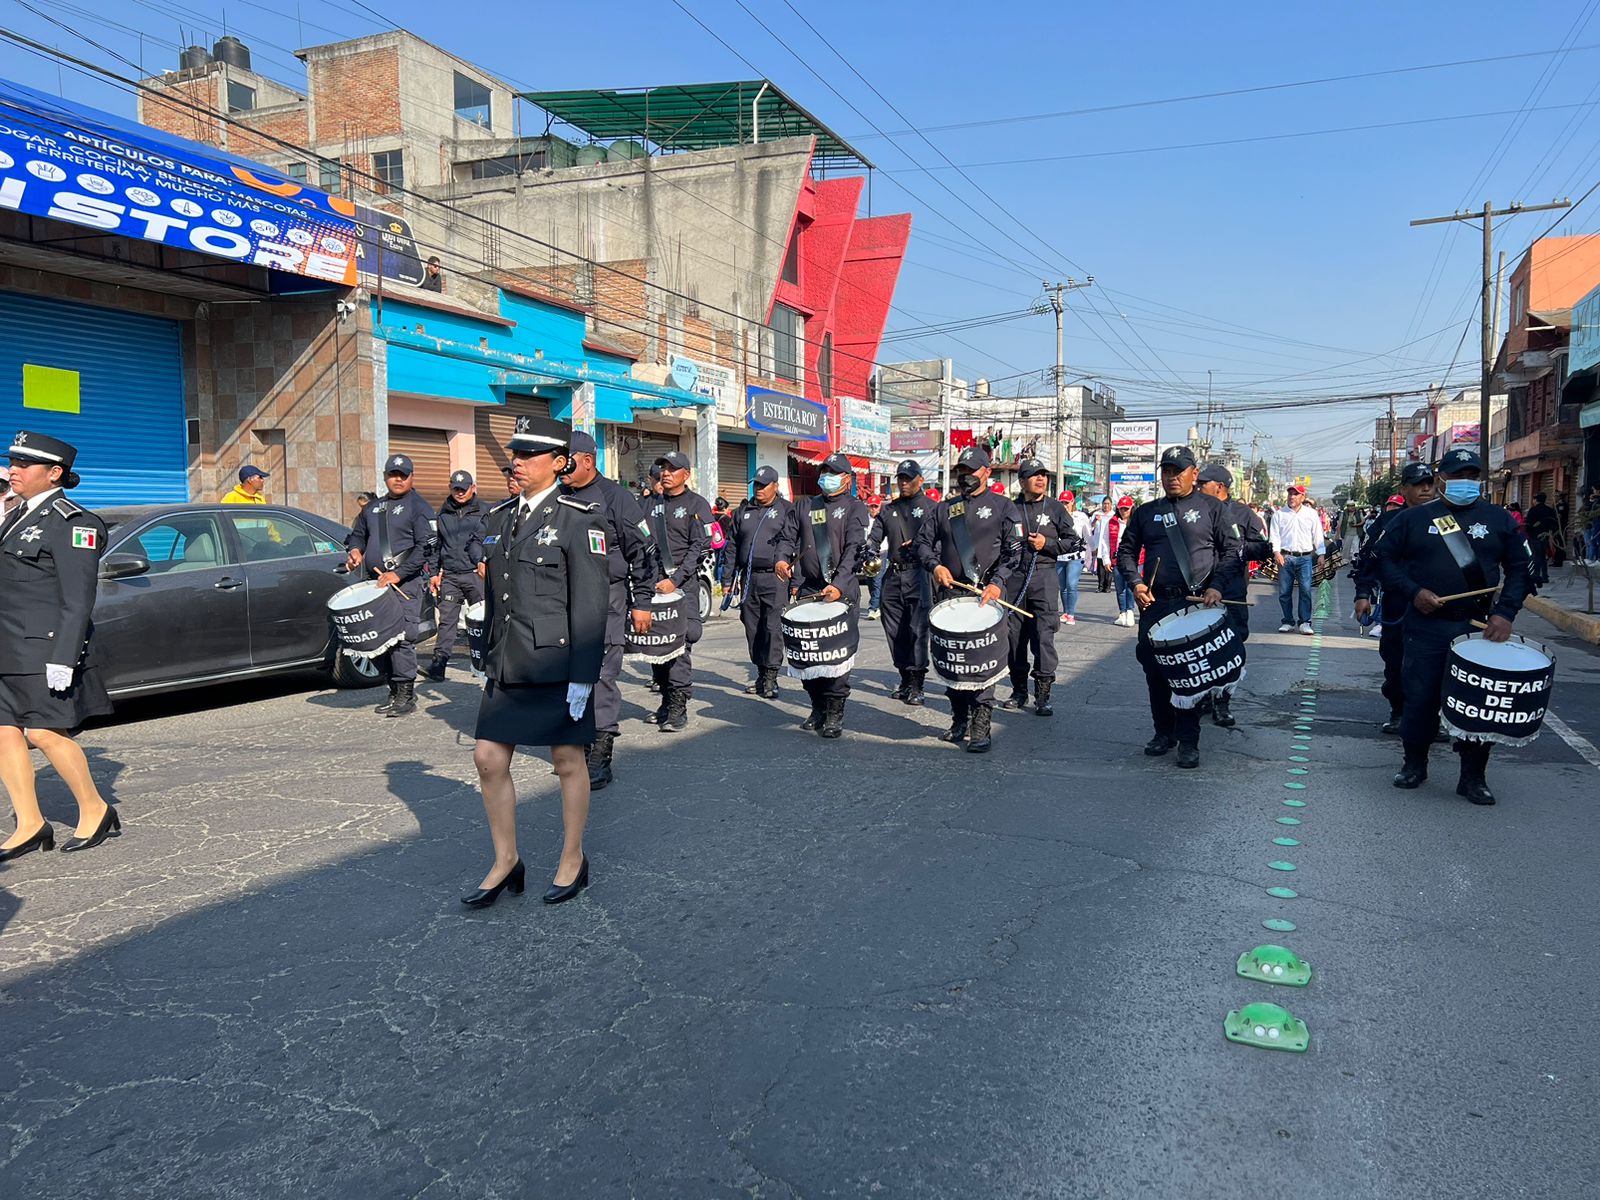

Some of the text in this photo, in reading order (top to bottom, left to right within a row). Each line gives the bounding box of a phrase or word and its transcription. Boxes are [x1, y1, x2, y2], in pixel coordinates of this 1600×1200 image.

[26, 142, 134, 180] FERRETERÍA
[138, 173, 150, 183] Y
[155, 179, 222, 202] MUCHO
[64, 131, 232, 187] ARTÍCULOS PARA:
[48, 192, 348, 282] STORE
[763, 401, 817, 428] ESTÉTICA ROY
[781, 621, 848, 639] SECRETARÍA
[786, 647, 848, 662] EGURIDAD
[800, 640, 819, 651] DE
[946, 651, 966, 663] DE
[1155, 627, 1235, 666] SECRETARÍA
[1168, 654, 1242, 689] SEGURIDAD
[1187, 658, 1211, 675] DE
[1446, 695, 1545, 724] SEGURIDAD
[1485, 694, 1514, 709] DE
